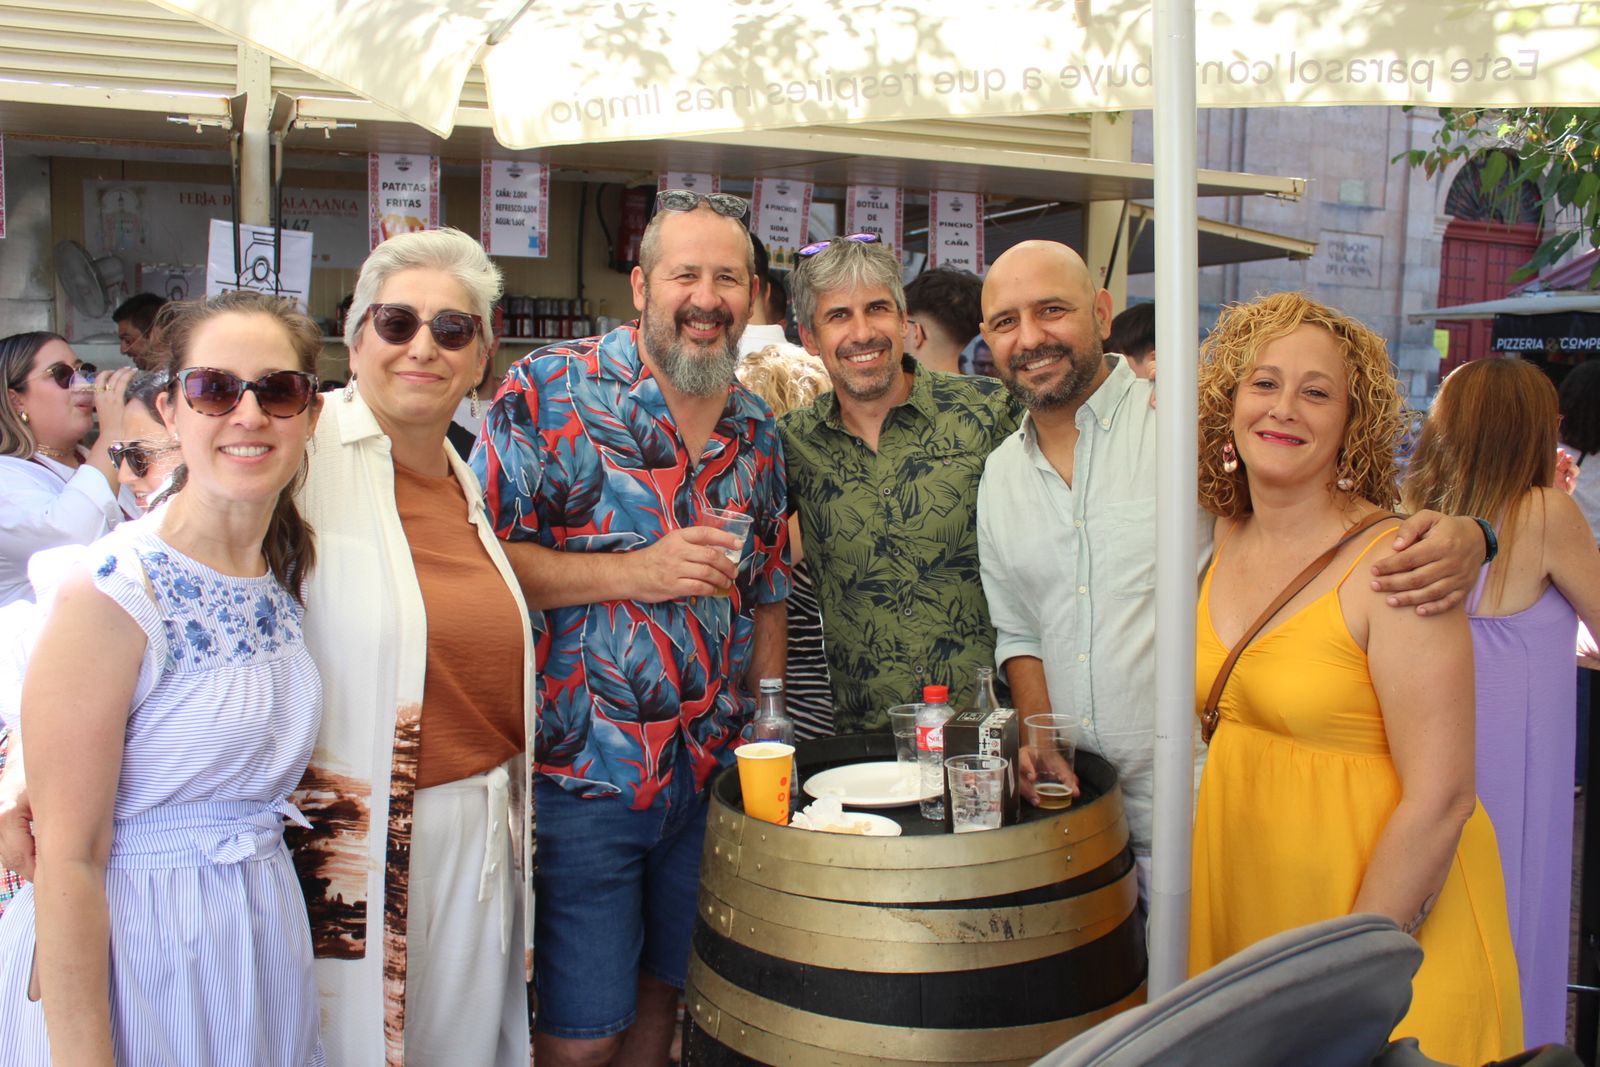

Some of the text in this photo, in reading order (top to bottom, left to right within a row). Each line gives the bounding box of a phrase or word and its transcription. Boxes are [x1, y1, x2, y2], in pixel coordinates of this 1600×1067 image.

[382, 182, 426, 192] PATATAS
[281, 196, 358, 211] ALAMANCA
[386, 199, 421, 208] FRITAS
[856, 200, 889, 209] BOTELLA
[770, 204, 797, 213] PINCHOS
[770, 224, 788, 233] SIDRA
[939, 221, 973, 229] PINCHO
[944, 239, 970, 247] CAÑA
[1496, 338, 1544, 350] PIZZERIA
